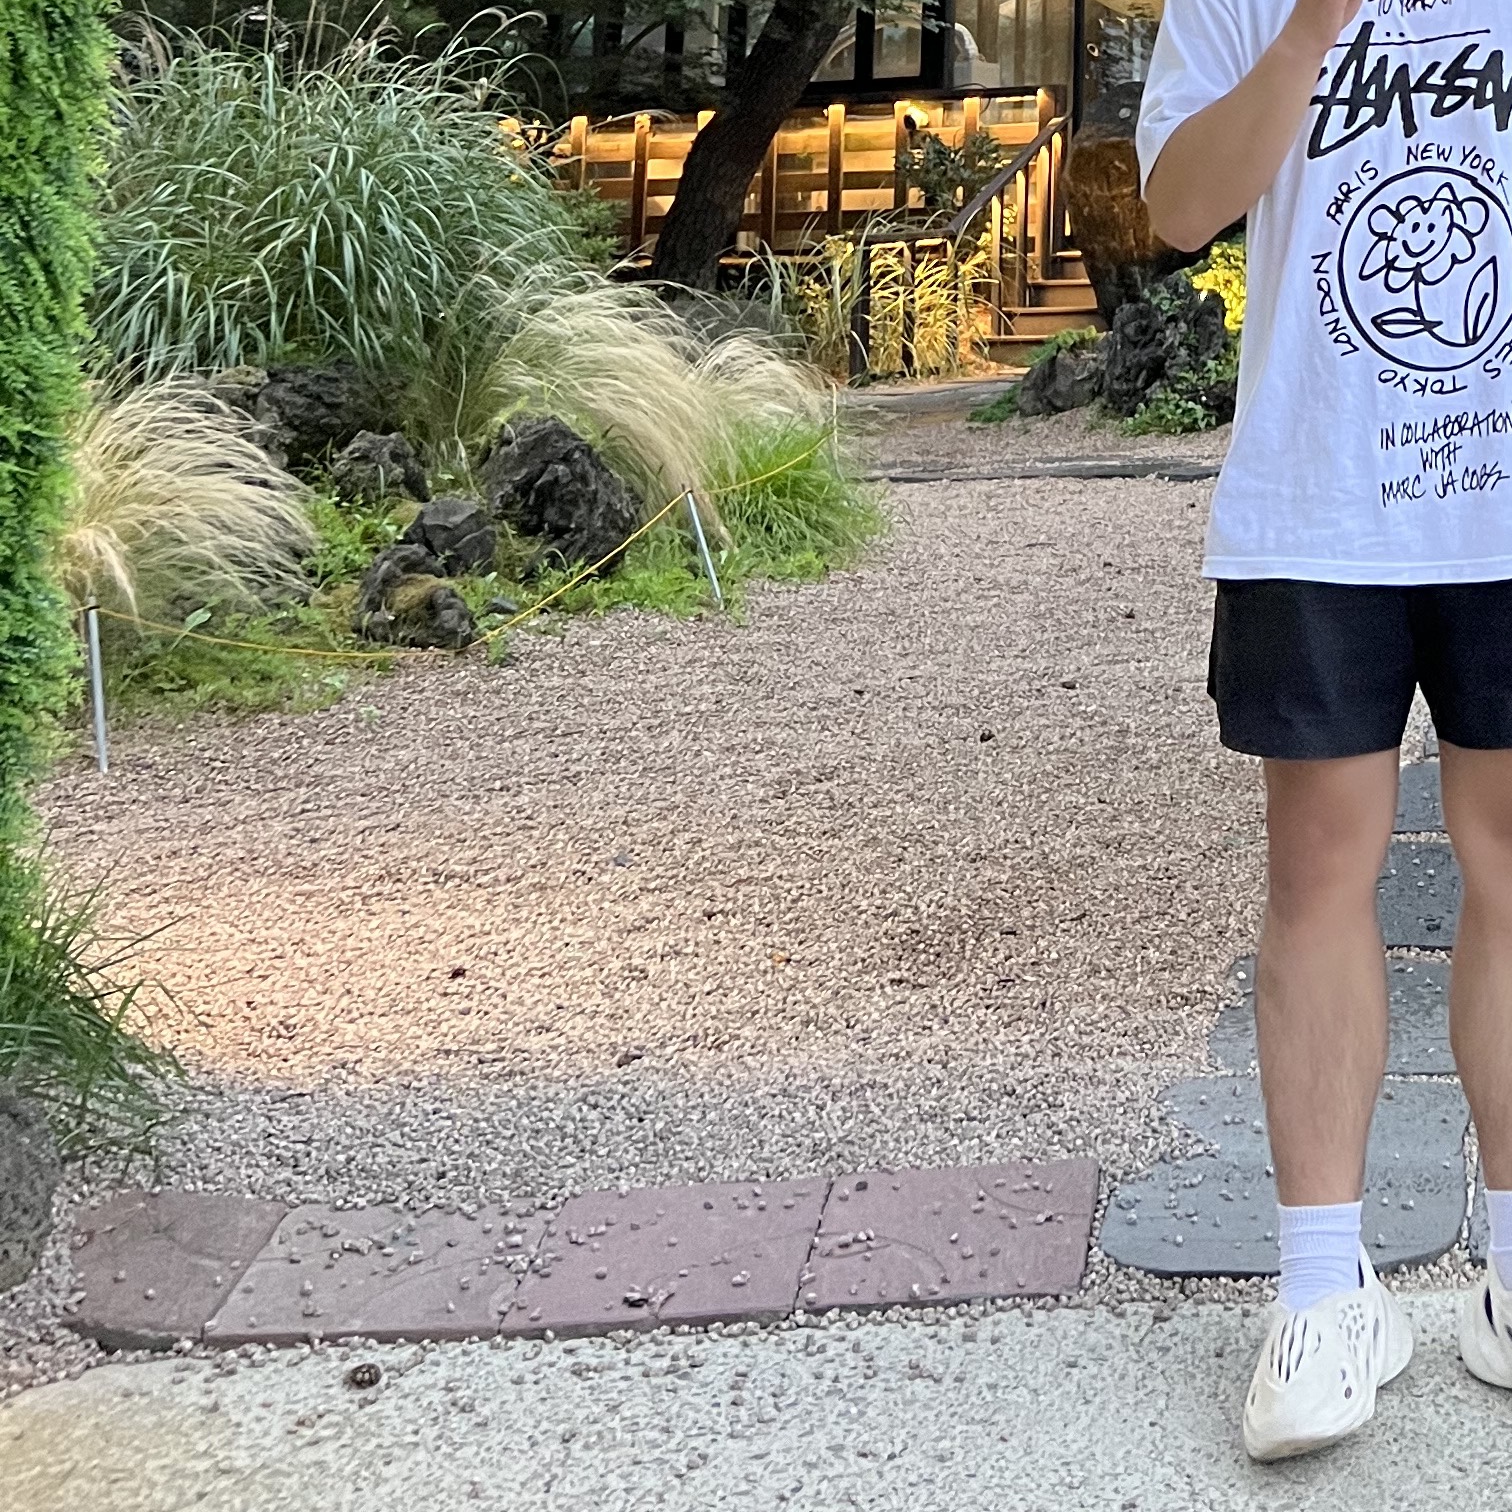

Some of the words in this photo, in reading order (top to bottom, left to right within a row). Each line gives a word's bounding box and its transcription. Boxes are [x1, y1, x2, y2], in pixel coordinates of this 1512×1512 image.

[1326, 159, 1379, 225] PARIS
[1406, 142, 1453, 165] NEW
[1459, 144, 1510, 206] YORK
[1311, 251, 1360, 356] LONDON
[1378, 369, 1468, 397] TOKYO
[1380, 421, 1396, 450] IN
[1420, 441, 1463, 473] WITH
[1381, 474, 1427, 508] MARC
[1434, 460, 1511, 499] JACOBS
